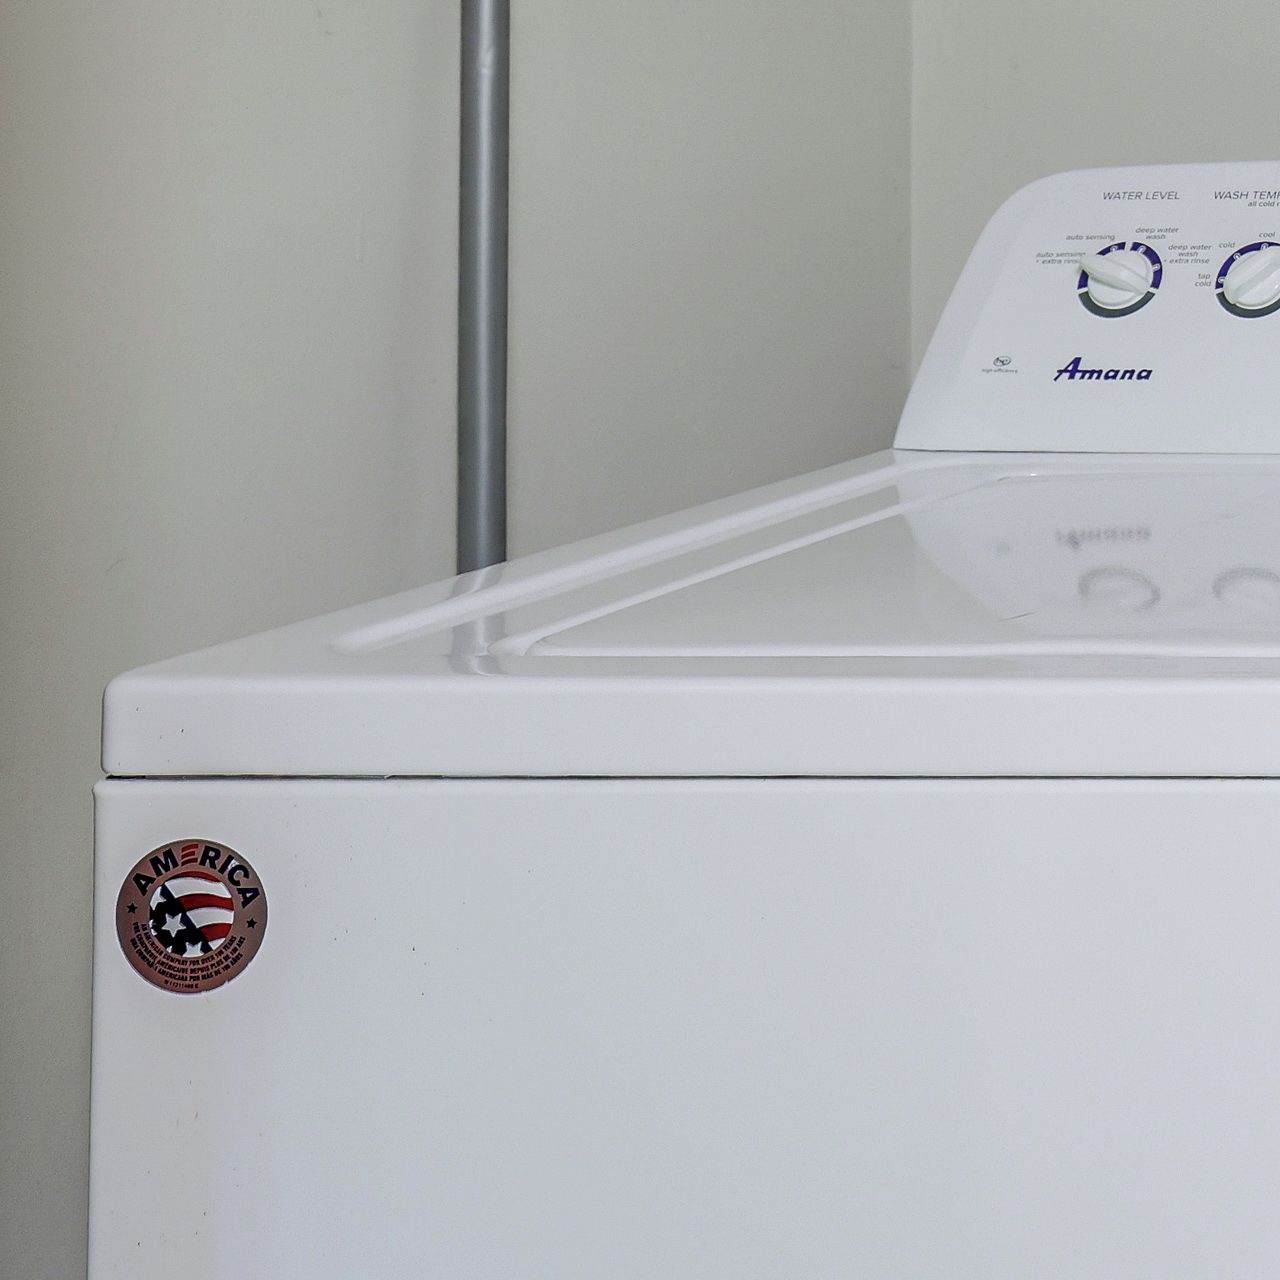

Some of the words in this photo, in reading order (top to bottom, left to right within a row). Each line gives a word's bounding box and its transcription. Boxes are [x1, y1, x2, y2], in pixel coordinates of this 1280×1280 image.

[1103, 191, 1142, 200] WATER
[1145, 191, 1180, 200] LEVEL
[1214, 191, 1249, 200] WASH
[1053, 357, 1153, 381] Amana
[132, 843, 260, 909] AMERICA
